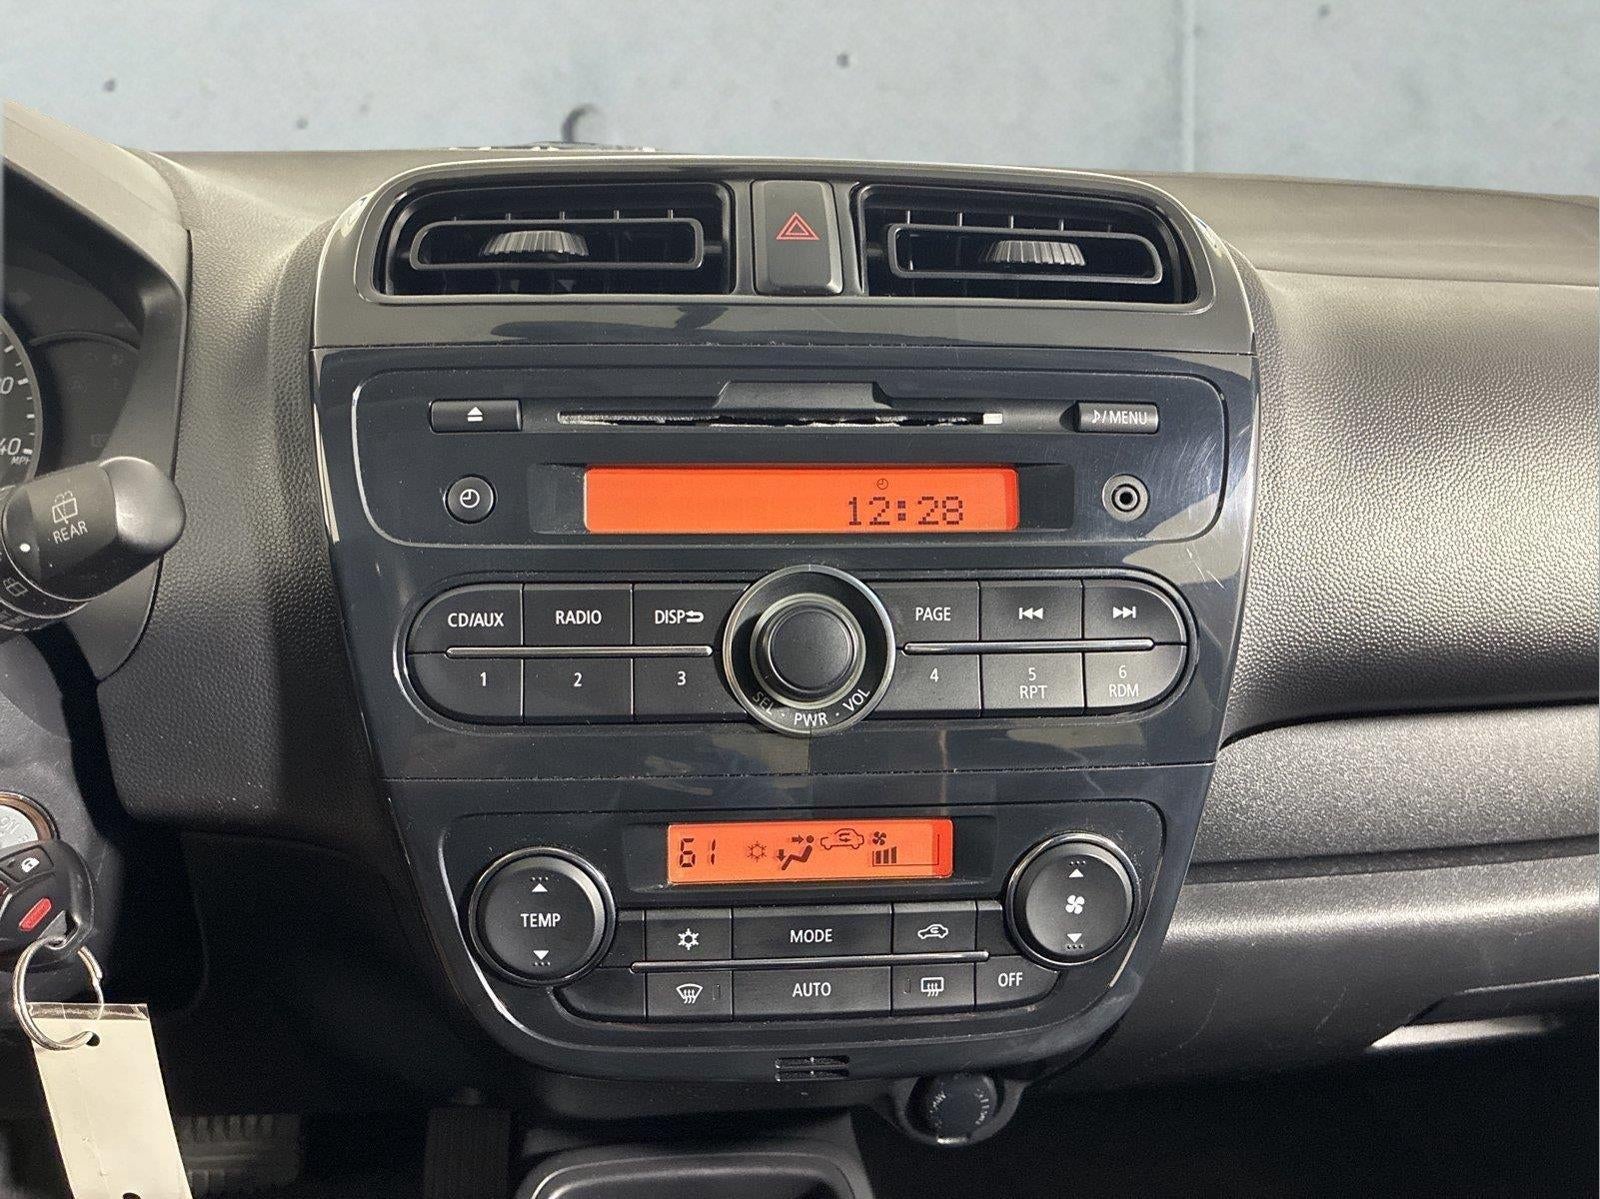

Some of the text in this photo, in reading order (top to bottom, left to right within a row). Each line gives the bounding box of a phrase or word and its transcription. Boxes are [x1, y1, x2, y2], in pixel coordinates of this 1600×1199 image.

[0, 376, 14, 395] 0
[849, 496, 964, 525] 12:28
[53, 520, 88, 544] REAR
[447, 612, 504, 628] CD/AUX
[555, 610, 602, 625] RADIO
[654, 610, 686, 625] DISP
[915, 606, 951, 622] PAGE
[479, 672, 487, 687] 1
[573, 672, 583, 687] 2
[677, 671, 686, 686] 3
[929, 667, 939, 683] 4
[1028, 666, 1037, 682] 5
[1118, 665, 1128, 679] 6
[1019, 685, 1048, 700] RPT
[1108, 684, 1140, 698] RDM
[752, 688, 871, 727] SEL PWR VOL
[679, 837, 717, 868] 61
[520, 912, 561, 928] TEMP
[790, 929, 833, 943] MODE
[998, 972, 1023, 988] OFF
[792, 982, 832, 998] AUTO
